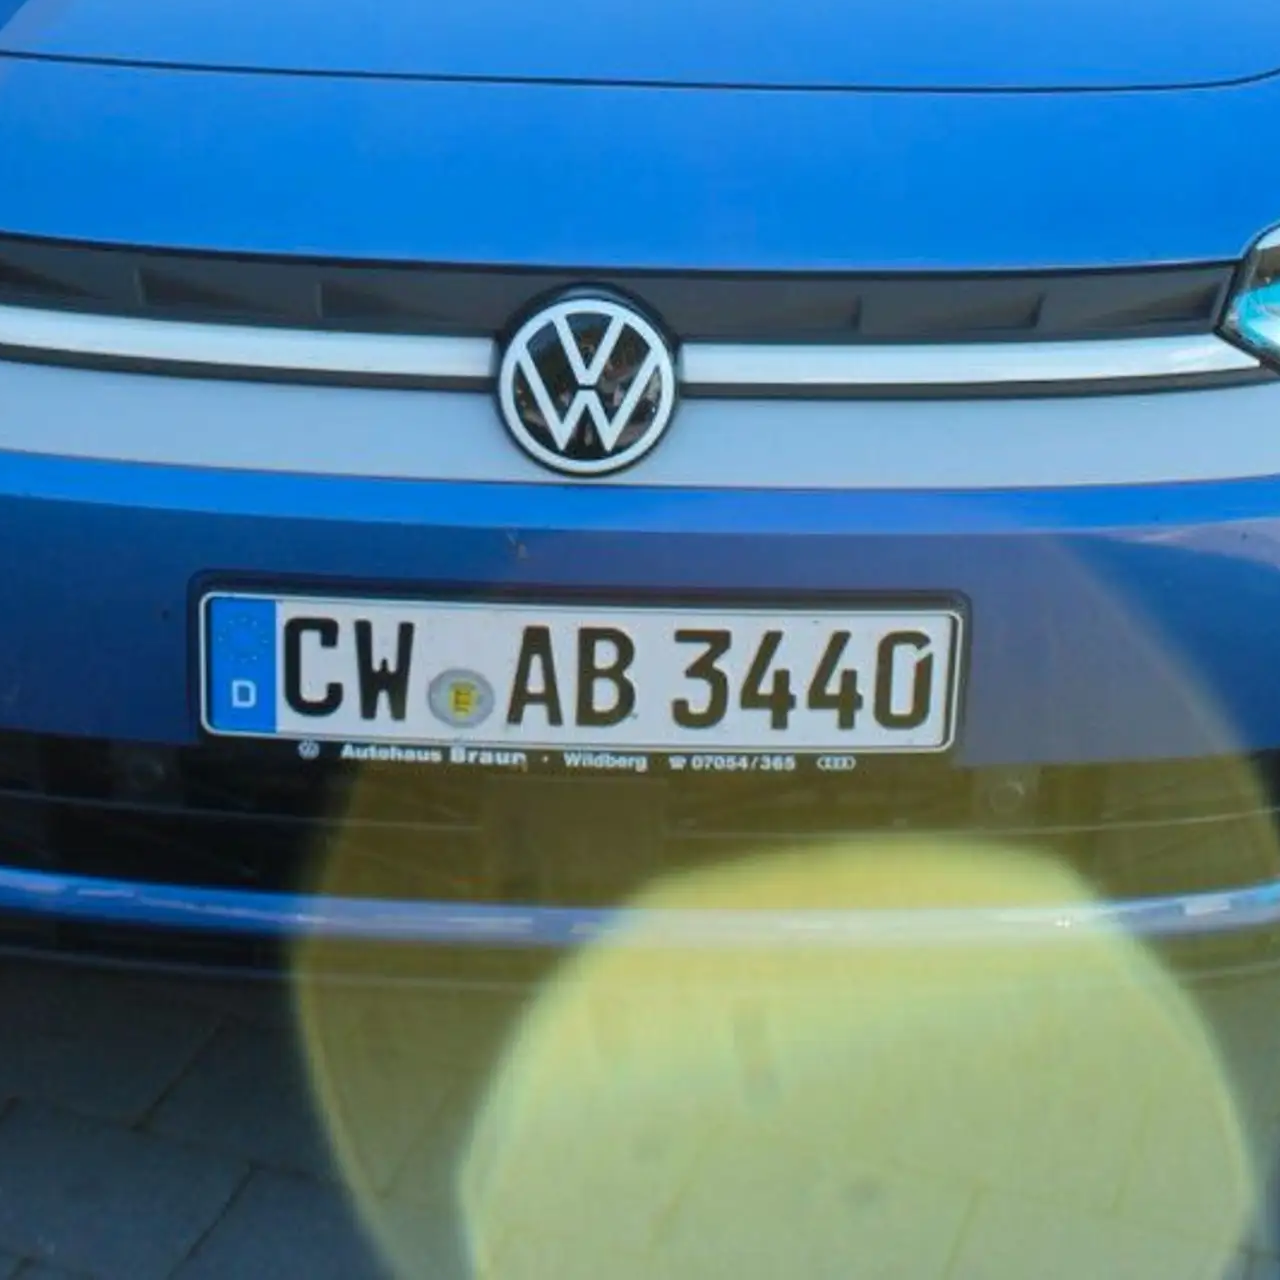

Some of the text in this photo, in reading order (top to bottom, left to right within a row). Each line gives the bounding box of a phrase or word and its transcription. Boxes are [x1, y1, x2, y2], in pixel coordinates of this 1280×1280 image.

[283, 616, 933, 731] CW AB 3440
[232, 680, 256, 709] D
[340, 743, 442, 763] Autohaus
[450, 745, 526, 768] Braun
[563, 750, 648, 772] Wildberg
